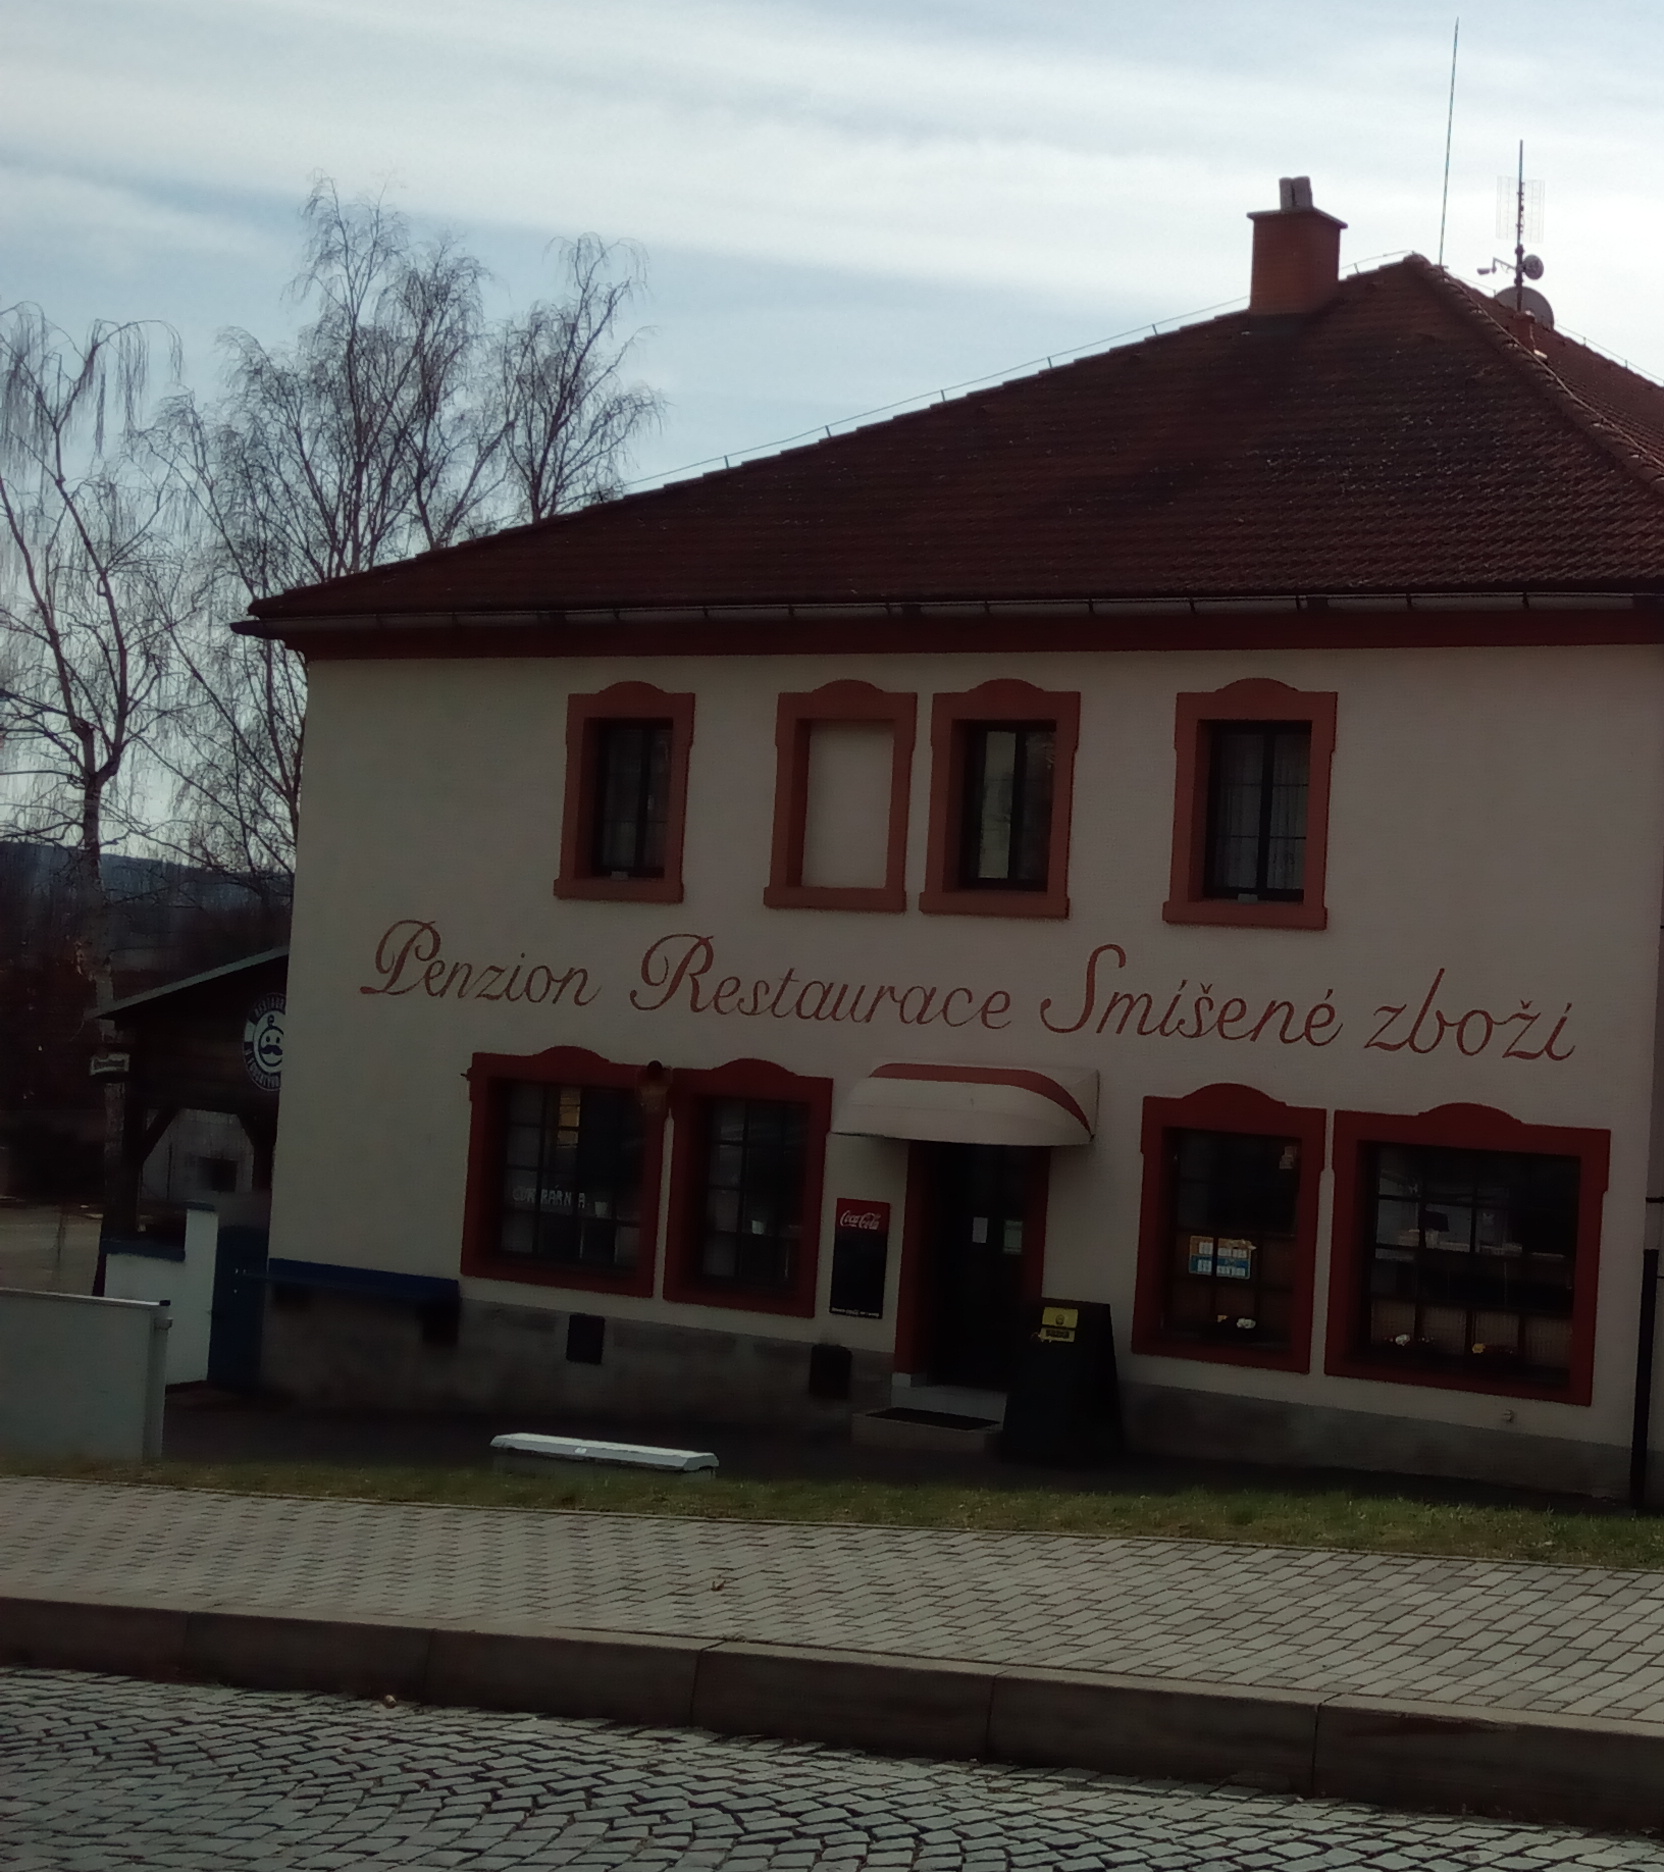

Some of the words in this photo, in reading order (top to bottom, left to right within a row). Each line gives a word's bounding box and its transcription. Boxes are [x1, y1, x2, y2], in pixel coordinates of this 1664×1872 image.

[360, 919, 601, 1006] Penzion
[630, 934, 1012, 1029] Restaurace
[1040, 944, 1343, 1046] Smíšené
[1364, 968, 1575, 1061] zboží
